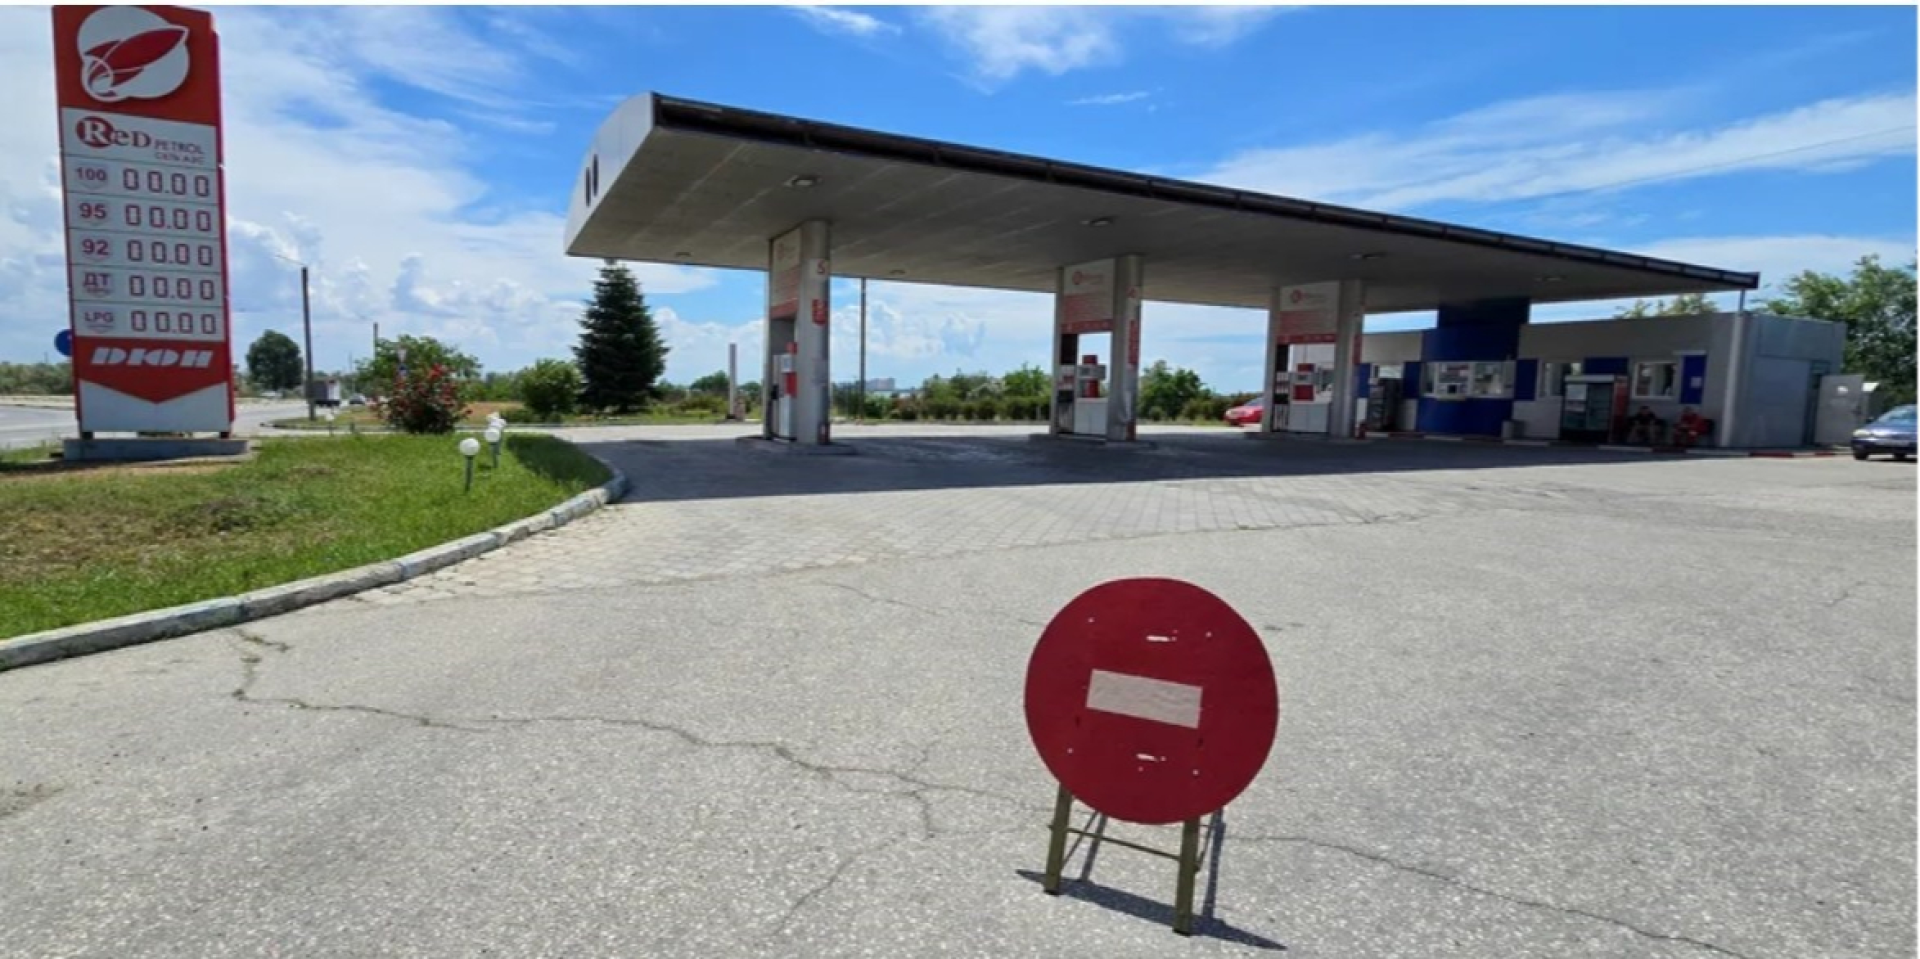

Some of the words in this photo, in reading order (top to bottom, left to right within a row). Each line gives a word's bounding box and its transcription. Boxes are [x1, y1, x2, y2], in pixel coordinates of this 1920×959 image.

[155, 139, 205, 154] PETROL
[76, 166, 108, 182] 100
[79, 202, 107, 220] 95
[82, 238, 109, 256] 92
[83, 272, 111, 287] ДТ
[84, 311, 114, 323] LPG
